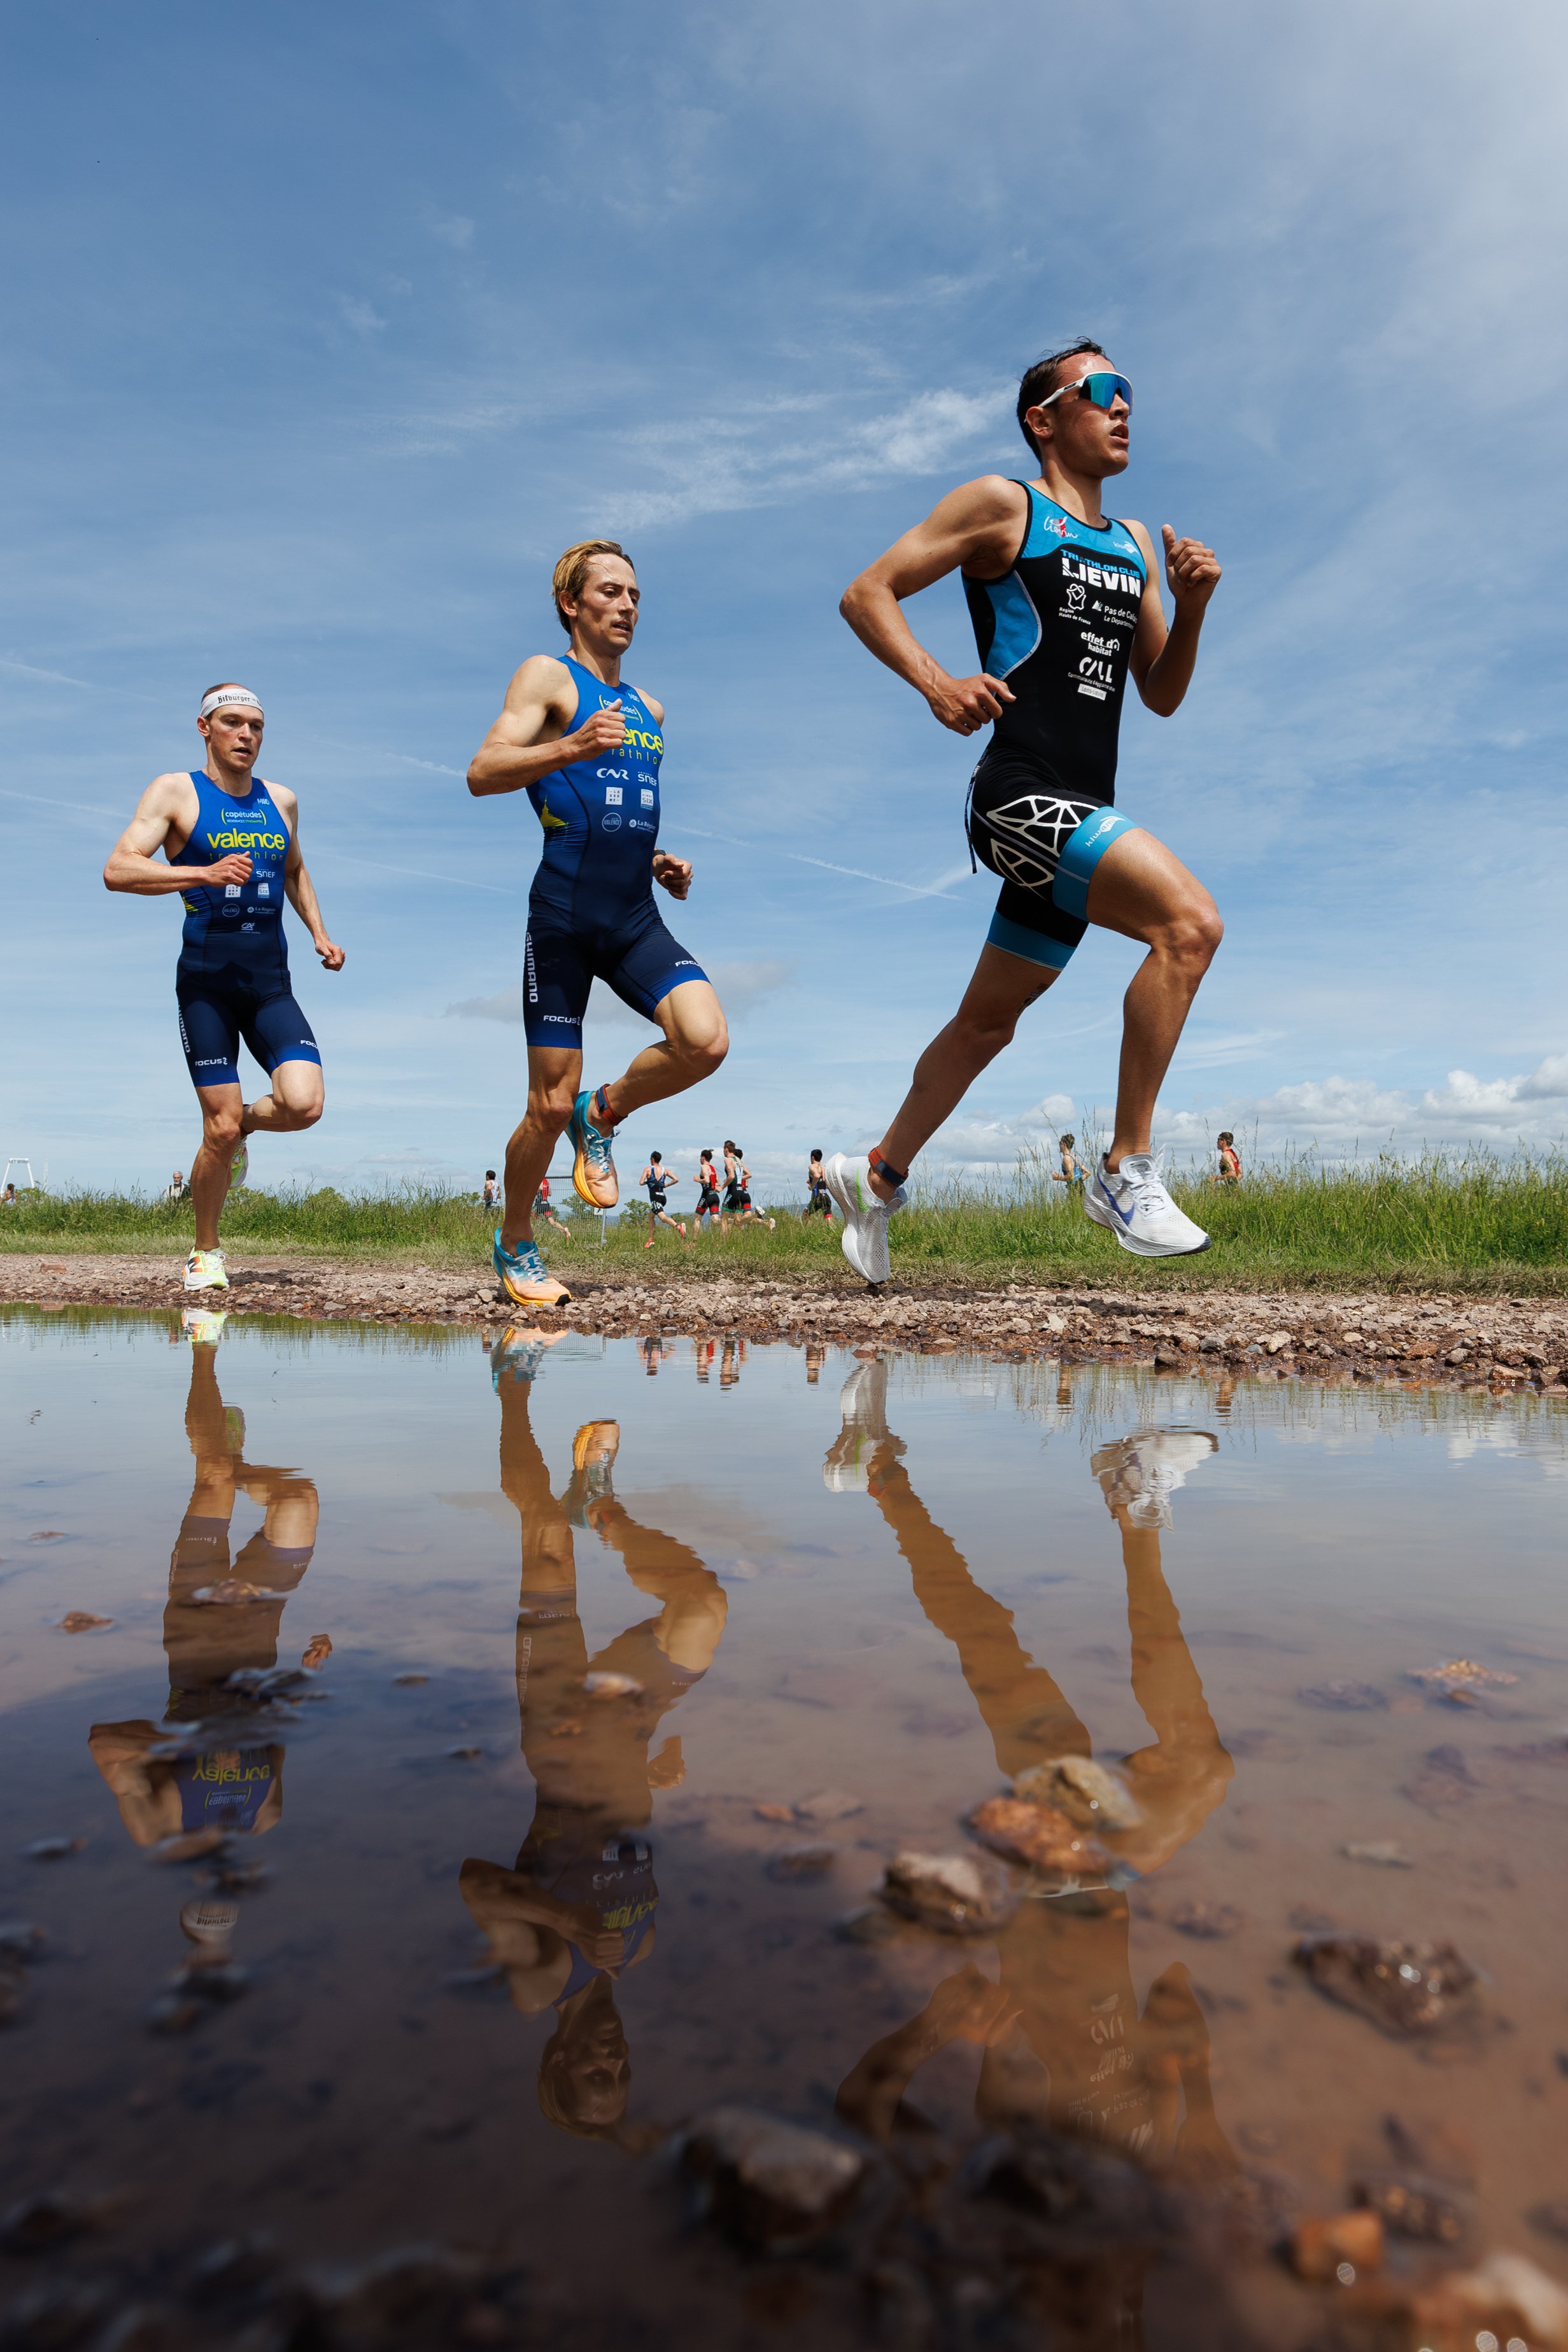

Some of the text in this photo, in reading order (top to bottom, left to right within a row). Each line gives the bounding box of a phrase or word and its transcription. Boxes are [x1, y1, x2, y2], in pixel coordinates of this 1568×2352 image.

[1061, 557, 1141, 599] LIEVIN
[1119, 567, 1140, 578] CLUB
[1105, 606, 1117, 615] Pas
[1117, 608, 1126, 618] de
[1080, 632, 1105, 646] effet
[1088, 642, 1112, 656] habitat
[218, 695, 250, 704] Bitburger
[623, 728, 663, 754] ence
[597, 768, 630, 780] CNR
[206, 828, 285, 850] valence
[526, 932, 538, 1003] SHIMANO
[543, 1015, 577, 1024] FOCUS
[195, 1058, 222, 1066] FOCUS
